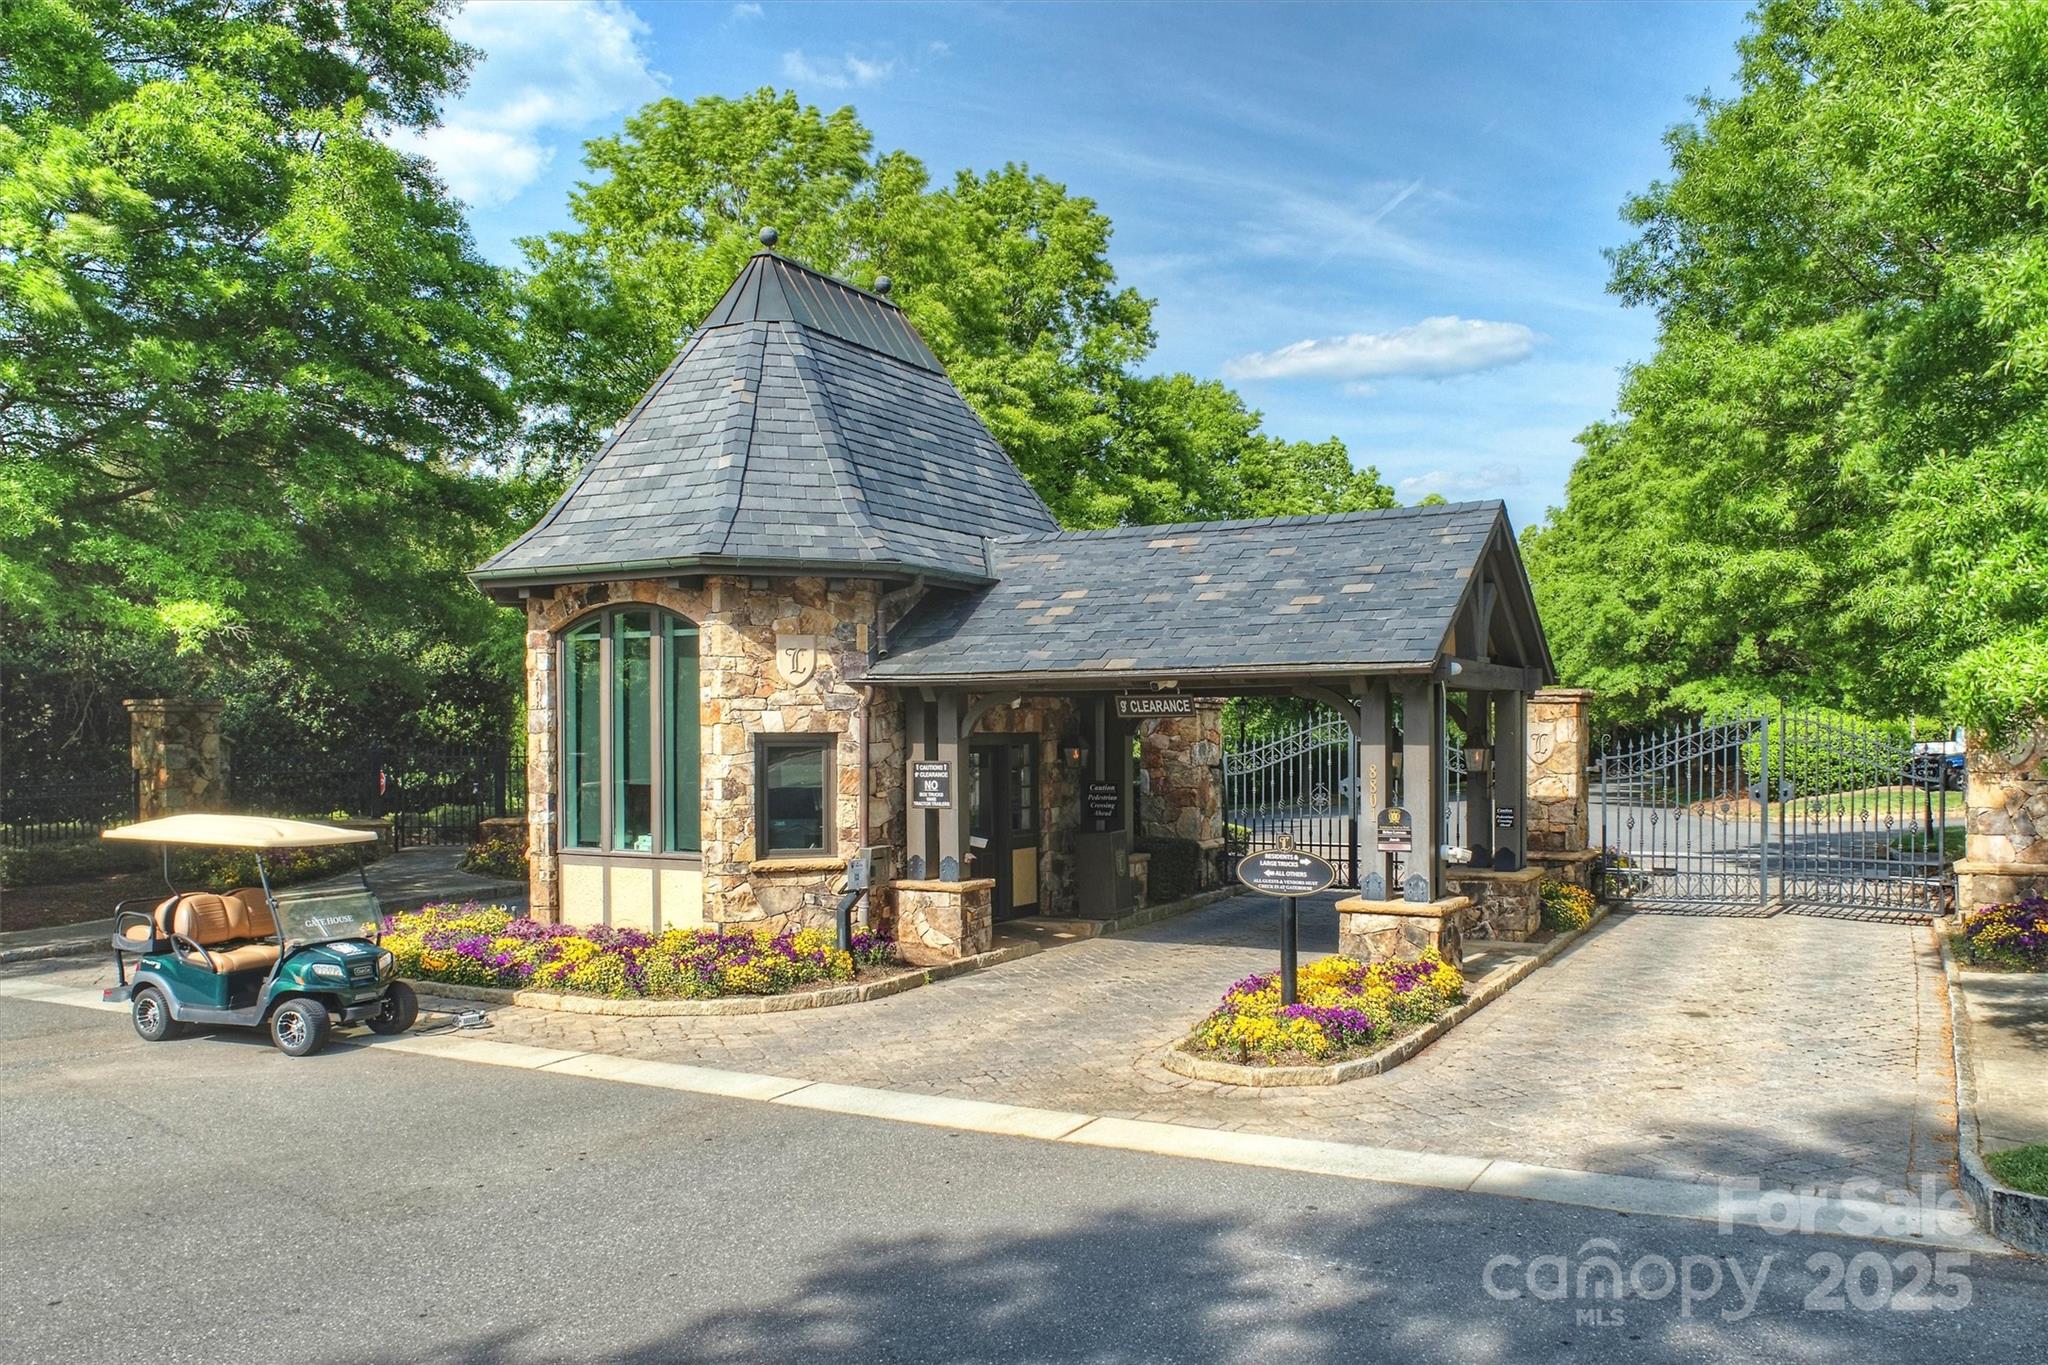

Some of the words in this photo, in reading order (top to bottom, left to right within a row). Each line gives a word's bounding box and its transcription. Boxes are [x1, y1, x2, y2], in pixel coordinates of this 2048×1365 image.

[1130, 700, 1191, 713] CLEARANCE
[924, 780, 938, 790] NO
[305, 918, 326, 928] GATE
[327, 915, 354, 924] HOUSE
